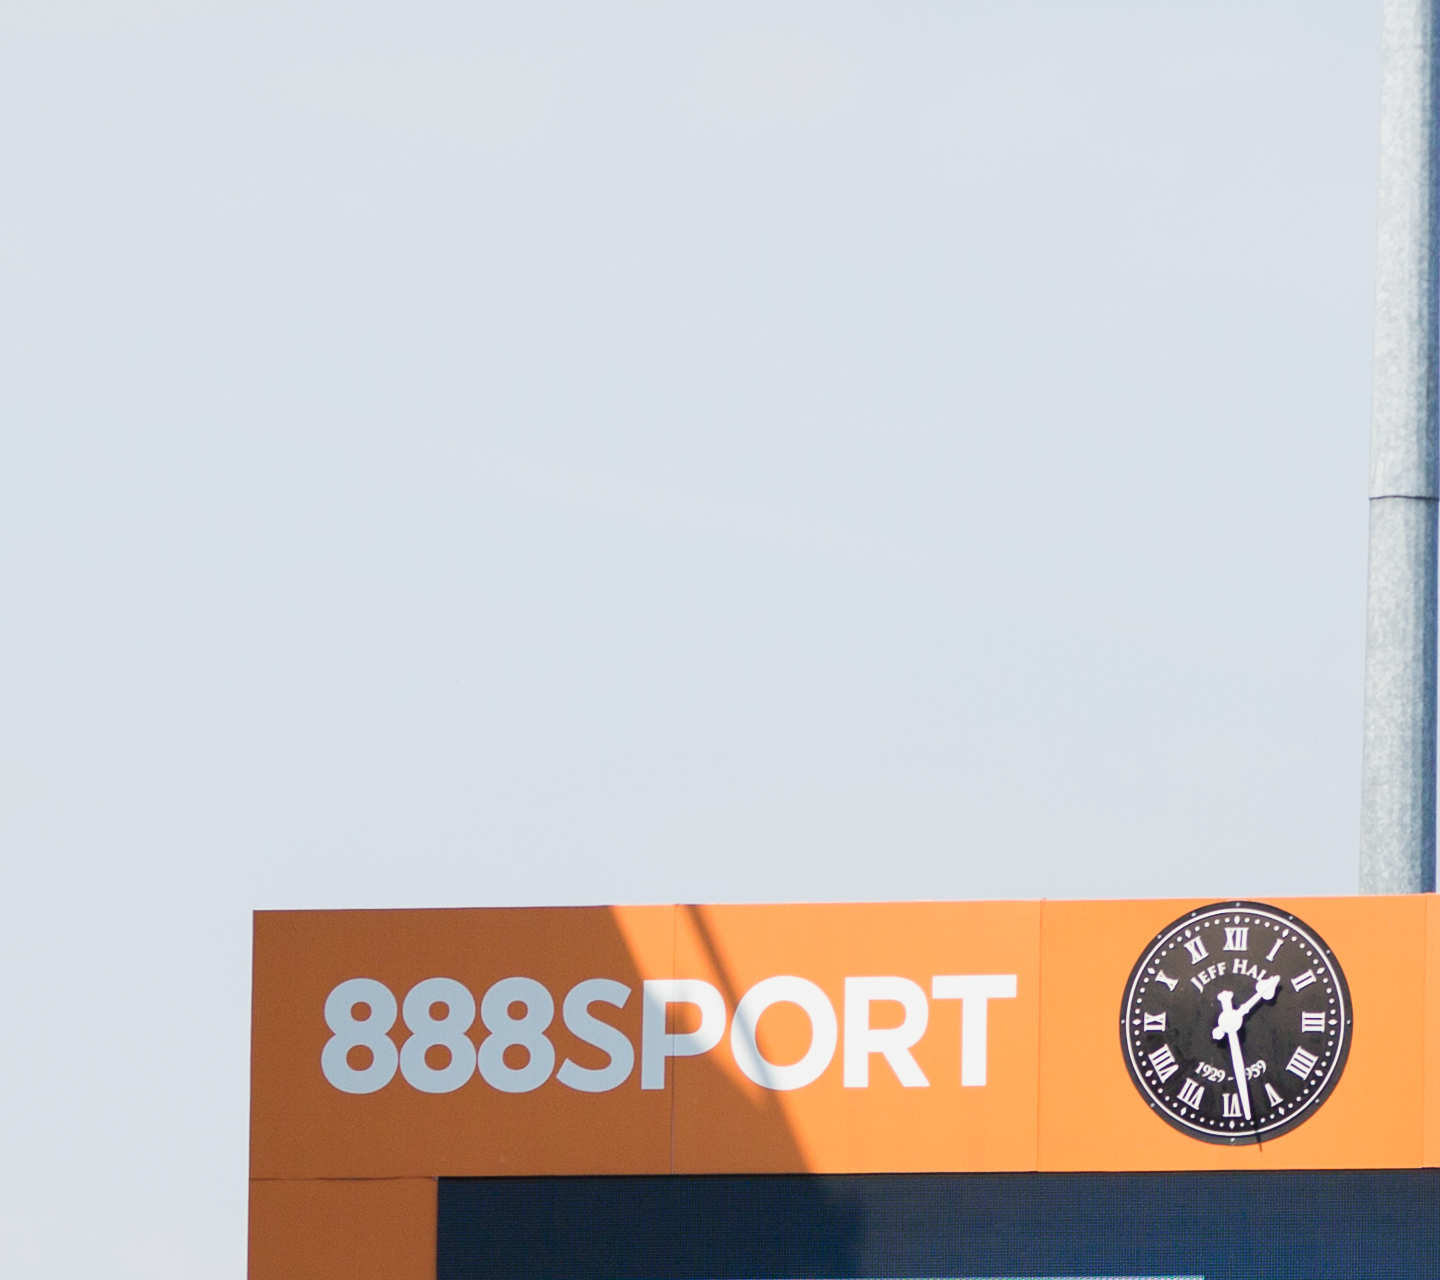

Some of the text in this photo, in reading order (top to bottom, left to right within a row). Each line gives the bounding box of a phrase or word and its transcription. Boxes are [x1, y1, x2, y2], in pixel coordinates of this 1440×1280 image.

[1184, 936, 1209, 964] XI
[1223, 927, 1249, 951] XII
[1266, 938, 1284, 961] I
[1155, 970, 1179, 992] X
[1190, 959, 1267, 993] JEFF HAL
[1291, 969, 1317, 992] II
[320, 973, 1018, 1094] 888SPORT
[1301, 1011, 1326, 1033] III
[1148, 1044, 1179, 1083] VIII
[1194, 1061, 1226, 1083] 1929
[1245, 1060, 1267, 1080] 959
[1177, 1077, 1205, 1110] VII
[1264, 1083, 1284, 1107] V
